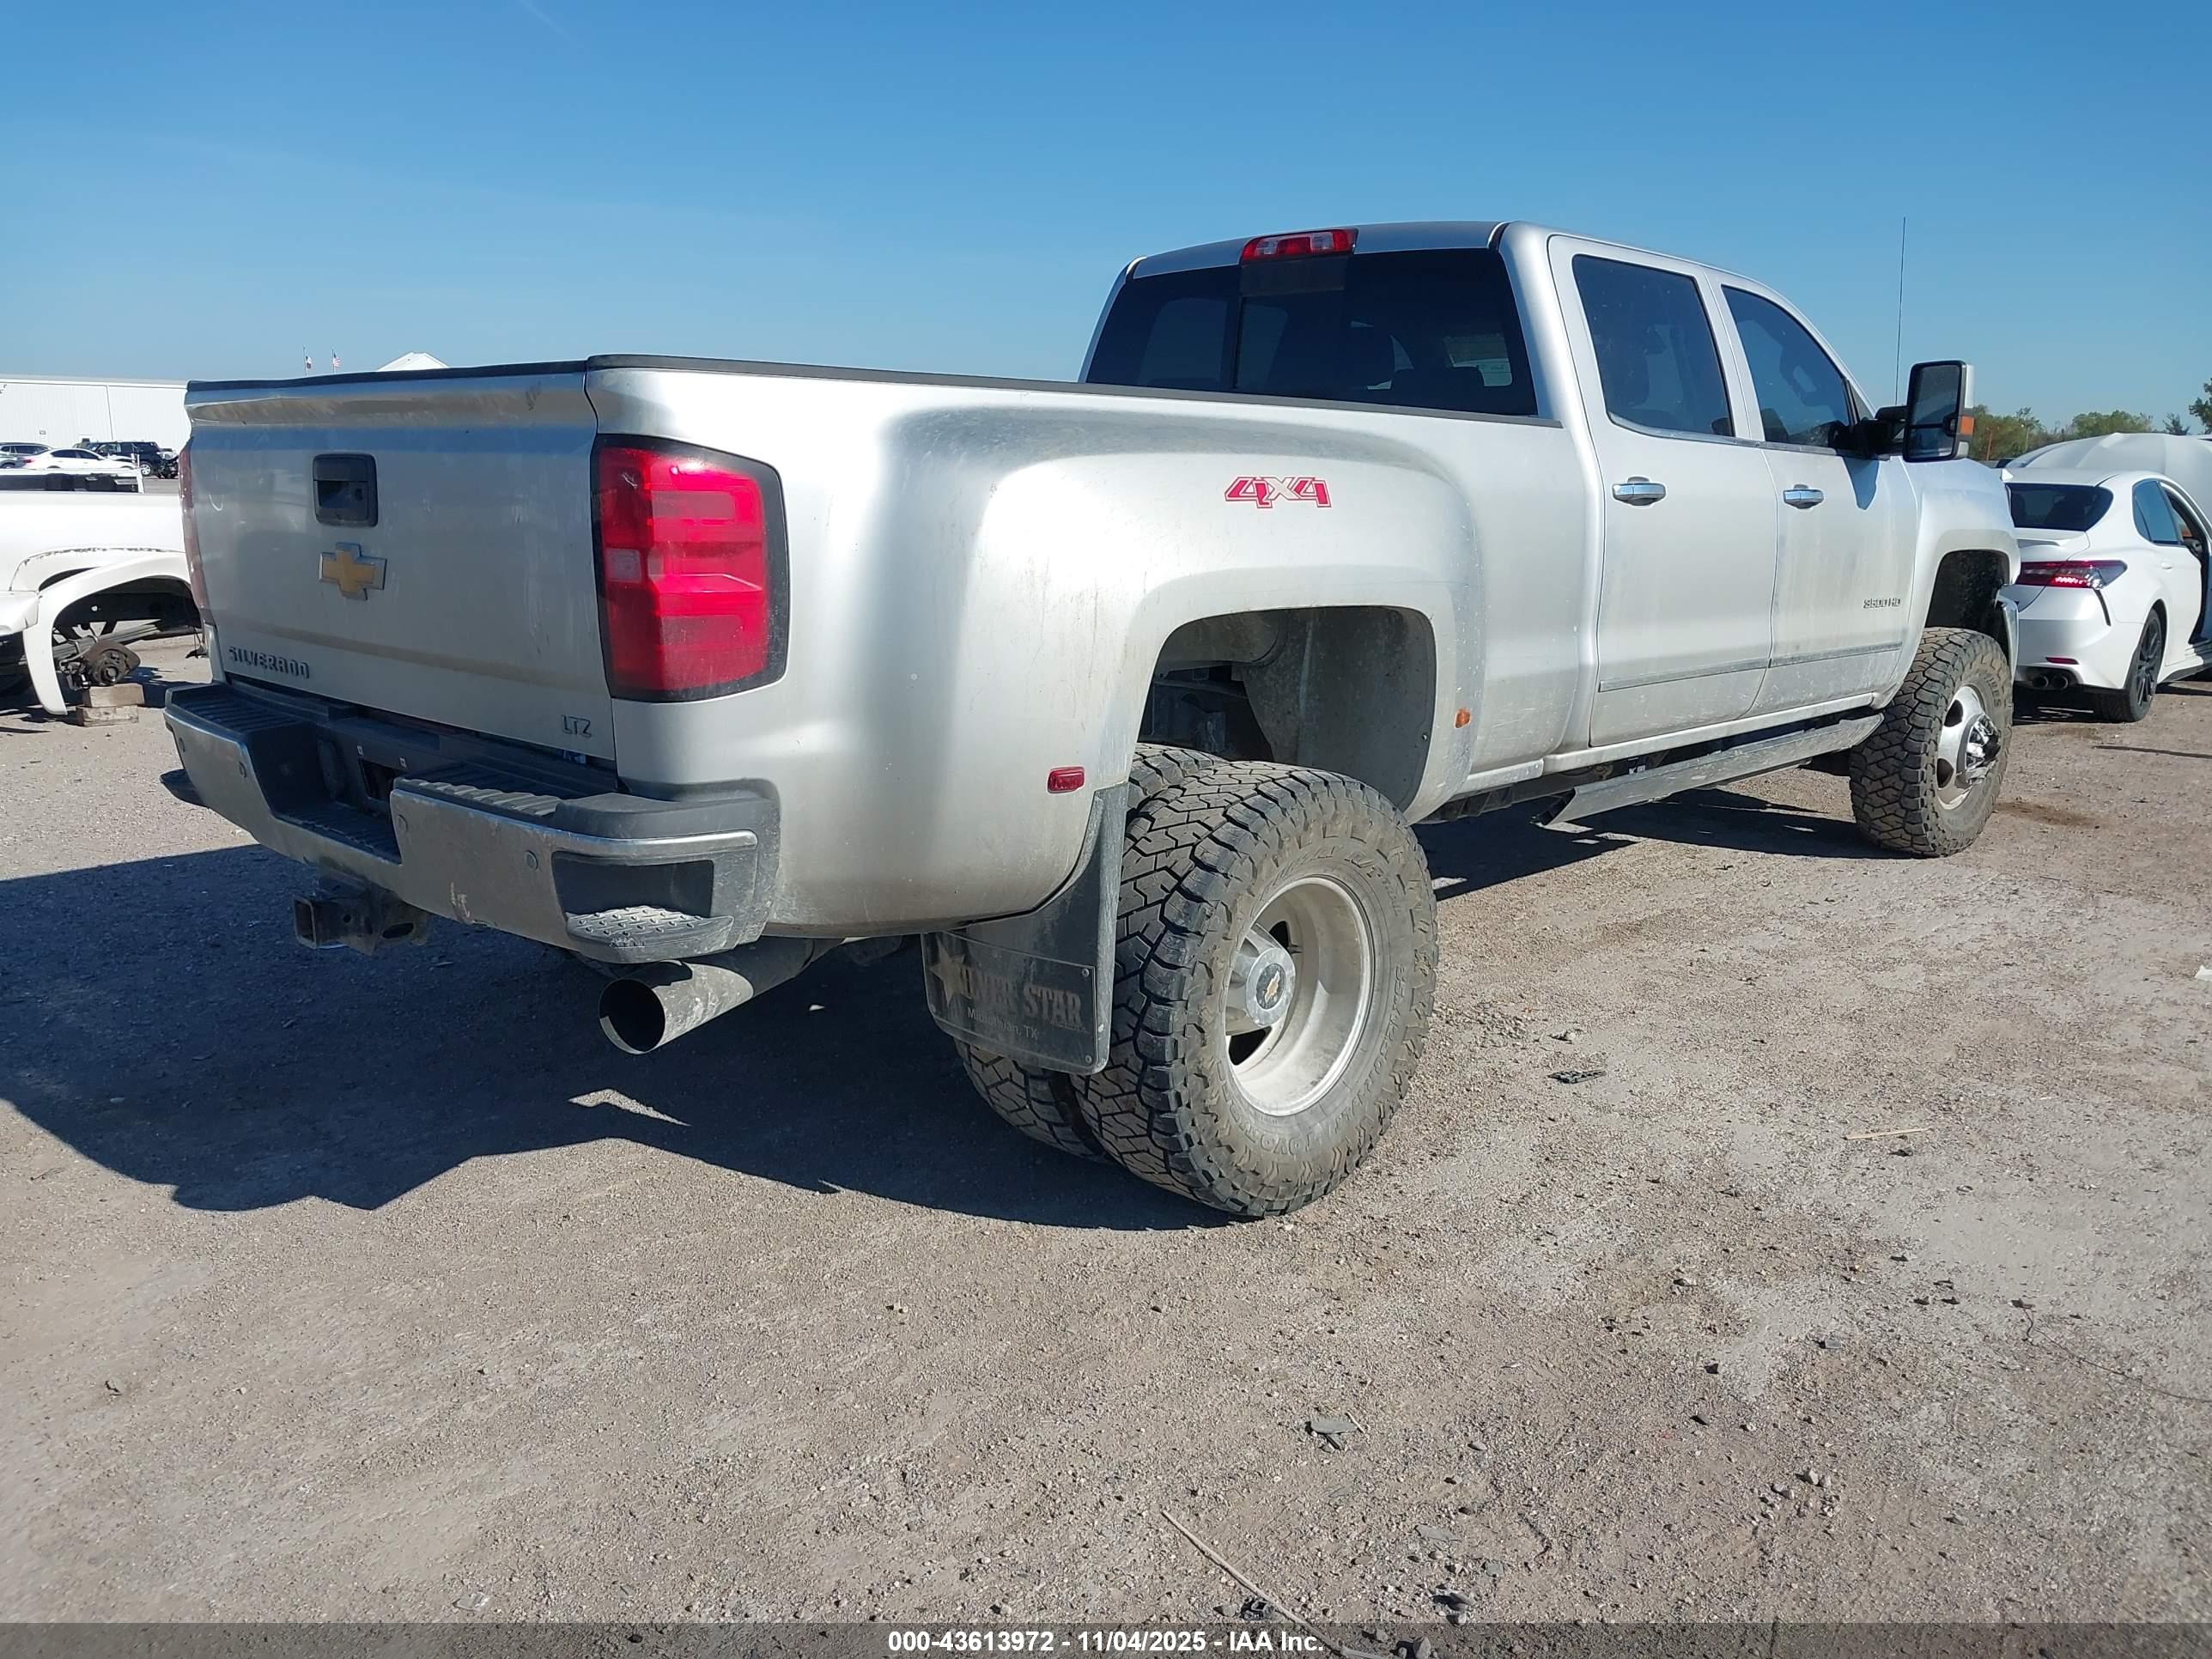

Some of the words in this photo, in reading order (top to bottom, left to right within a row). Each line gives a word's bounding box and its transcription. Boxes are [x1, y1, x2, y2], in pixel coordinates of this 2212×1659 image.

[228, 646, 310, 679] SILVERADO
[561, 714, 592, 738] LTZ
[1023, 984, 1082, 1025] STAR
[1023, 1024, 1037, 1040] TX
